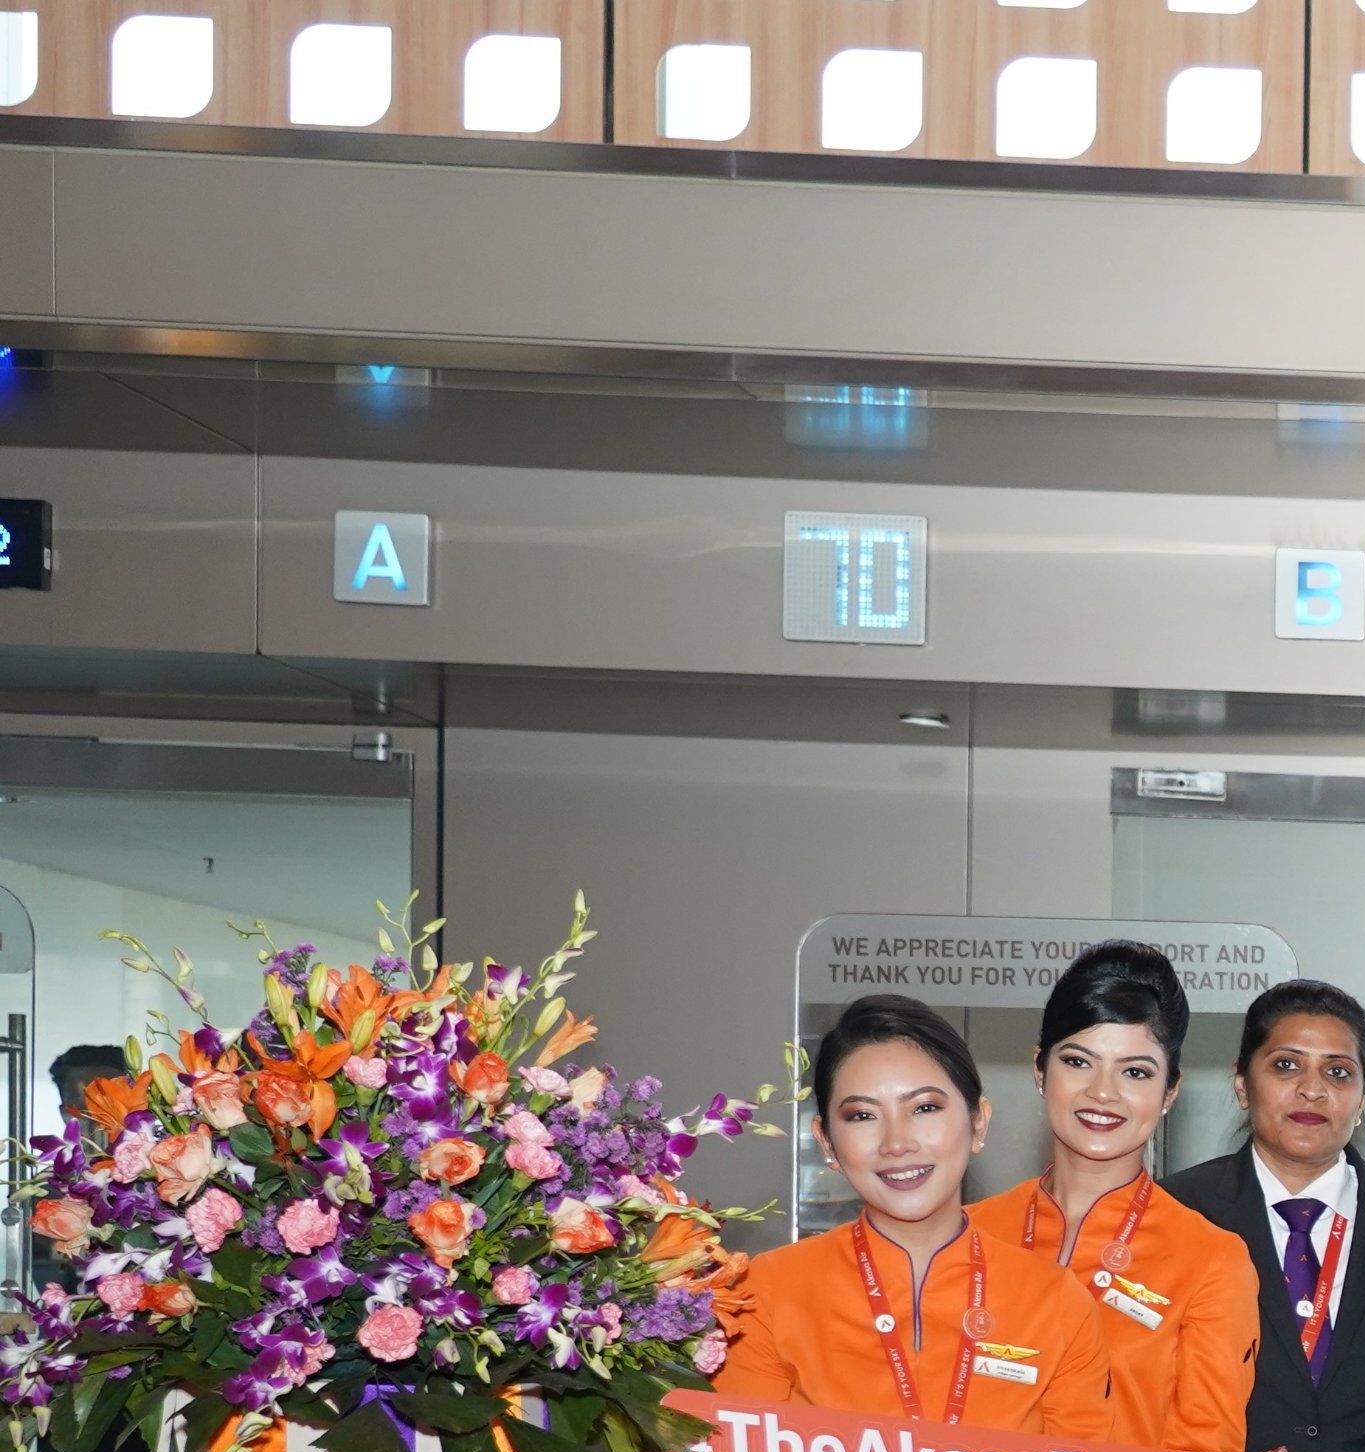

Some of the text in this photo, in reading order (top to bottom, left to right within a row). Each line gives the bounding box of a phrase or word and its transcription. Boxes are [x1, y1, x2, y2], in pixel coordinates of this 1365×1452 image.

[352, 522, 408, 591] A
[1296, 561, 1343, 626] B
[832, 936, 870, 957] WE
[875, 938, 1024, 960] APPRECIATE
[1216, 945, 1265, 964] AND
[828, 963, 910, 985] THANK
[916, 966, 963, 986] YOU
[970, 967, 1017, 987] FOR
